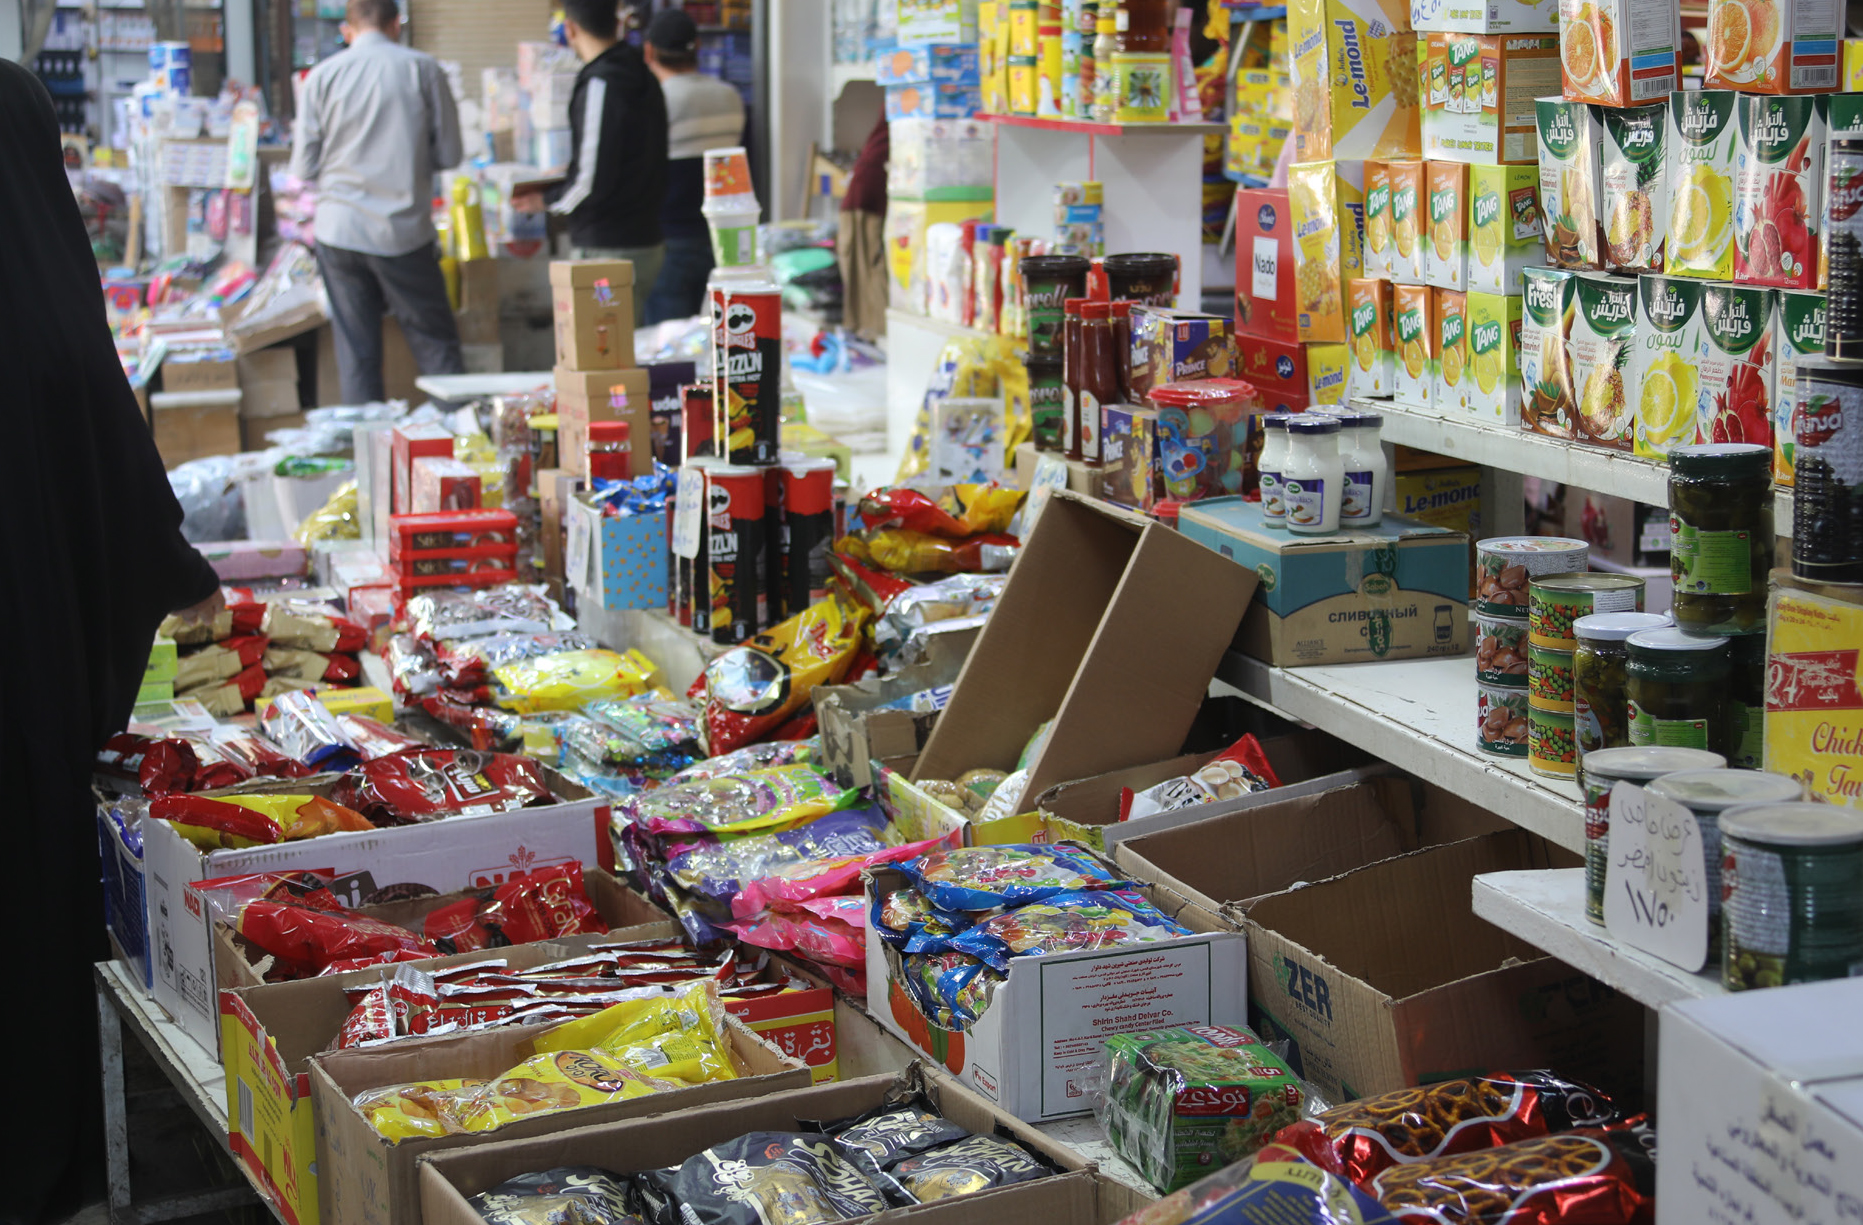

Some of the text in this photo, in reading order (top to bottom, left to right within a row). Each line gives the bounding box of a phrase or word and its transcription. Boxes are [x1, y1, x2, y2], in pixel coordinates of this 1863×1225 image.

[1335, 20, 1370, 108] Le-mond
[1452, 41, 1475, 64] TANG
[1369, 189, 1389, 216] TANG
[1394, 190, 1413, 218] TANG
[1433, 193, 1454, 219] TANG
[1476, 196, 1497, 224] TANG
[1255, 253, 1275, 275] Nado
[1527, 284, 1560, 309] Fresh
[1354, 307, 1373, 334] TANG
[1400, 313, 1421, 340] TANG
[1442, 319, 1460, 345] TANG
[1714, 310, 1751, 338] فريش
[1474, 325, 1498, 352] TANG
[1175, 360, 1206, 378] PRINCE
[1284, 956, 1333, 1022] ZER
[1092, 1009, 1174, 1026] Shirin Shahd Delvar Co.
[1119, 1023, 1134, 1031] candy
[1135, 1020, 1152, 1028] Center
[1287, 1085, 1296, 1095] 5
